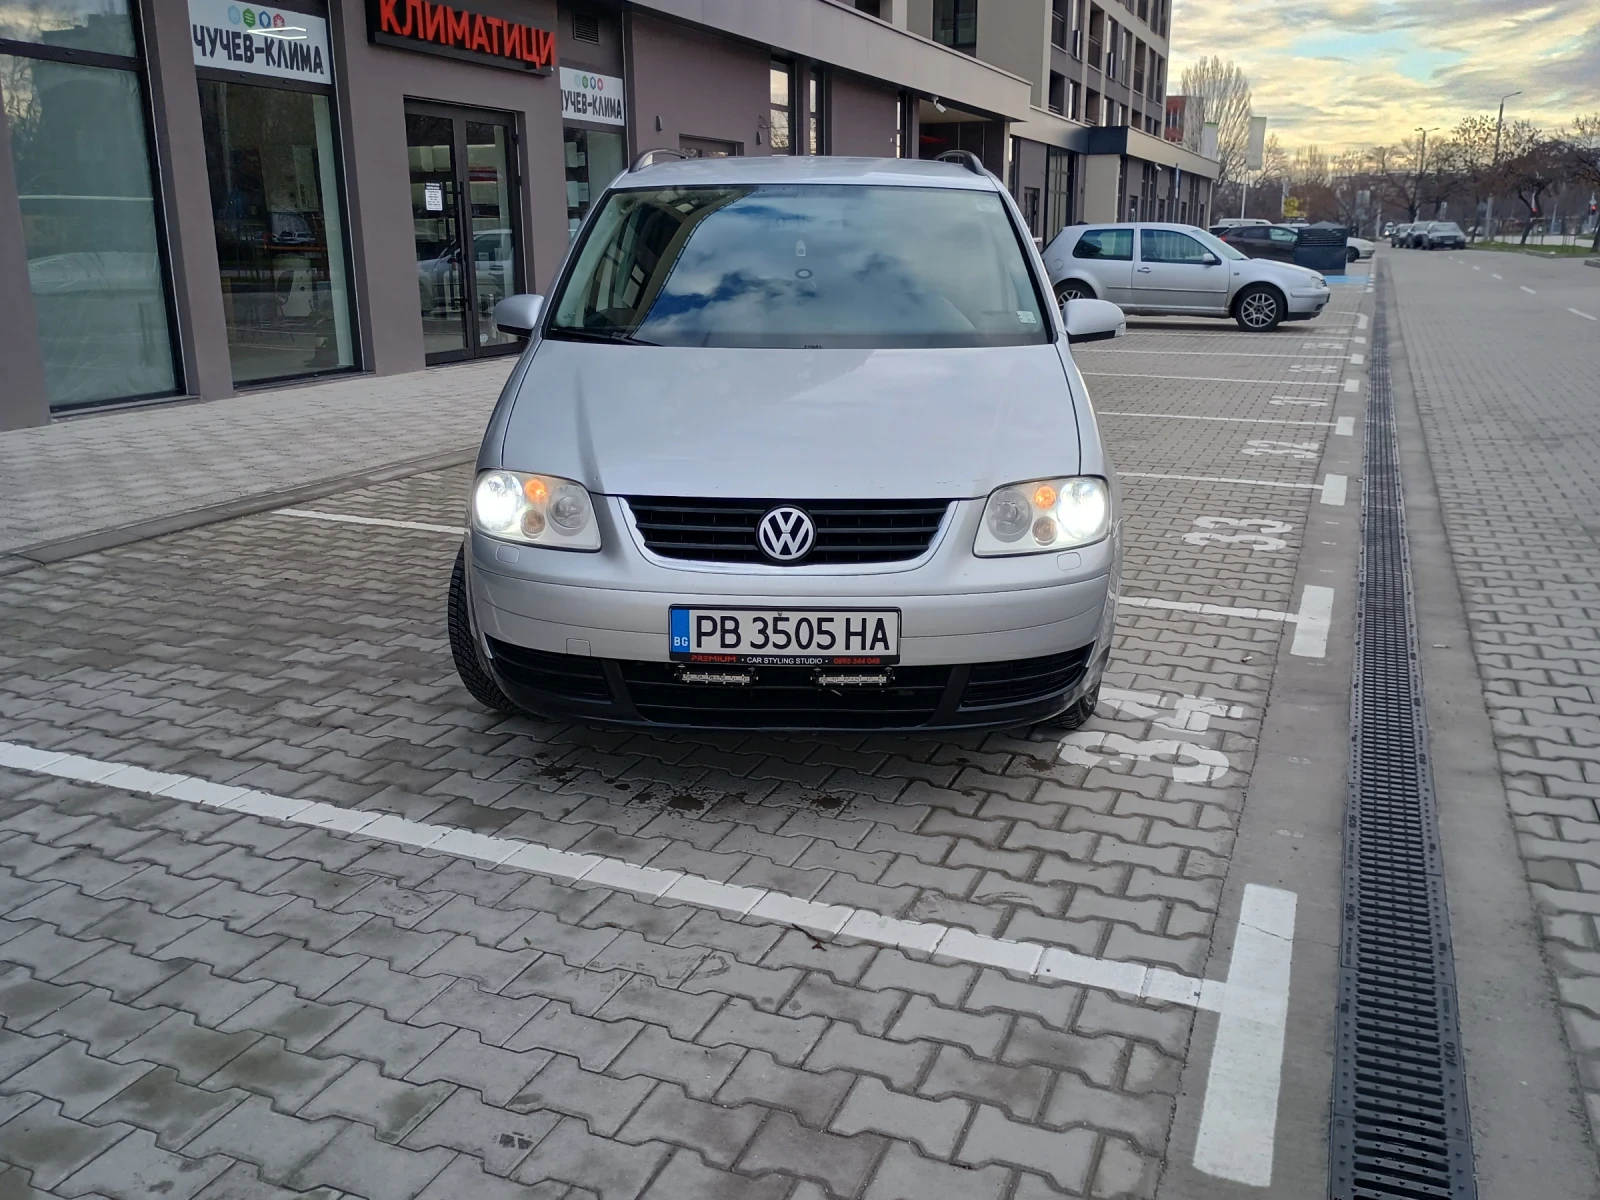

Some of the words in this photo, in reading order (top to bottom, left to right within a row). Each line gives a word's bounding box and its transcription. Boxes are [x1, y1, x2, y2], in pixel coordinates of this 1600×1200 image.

[193, 24, 324, 74] ЧУЧЕВ-КЛИМА
[380, 0, 556, 69] КЛИМАТИЦИ
[759, 507, 814, 560] VW
[1181, 516, 1292, 551] 33
[674, 637, 689, 647] BG
[697, 616, 741, 649] PB
[750, 617, 836, 650] 3505
[845, 618, 890, 650] HA
[691, 655, 737, 663] PREMIUM
[764, 657, 794, 665] STYLING
